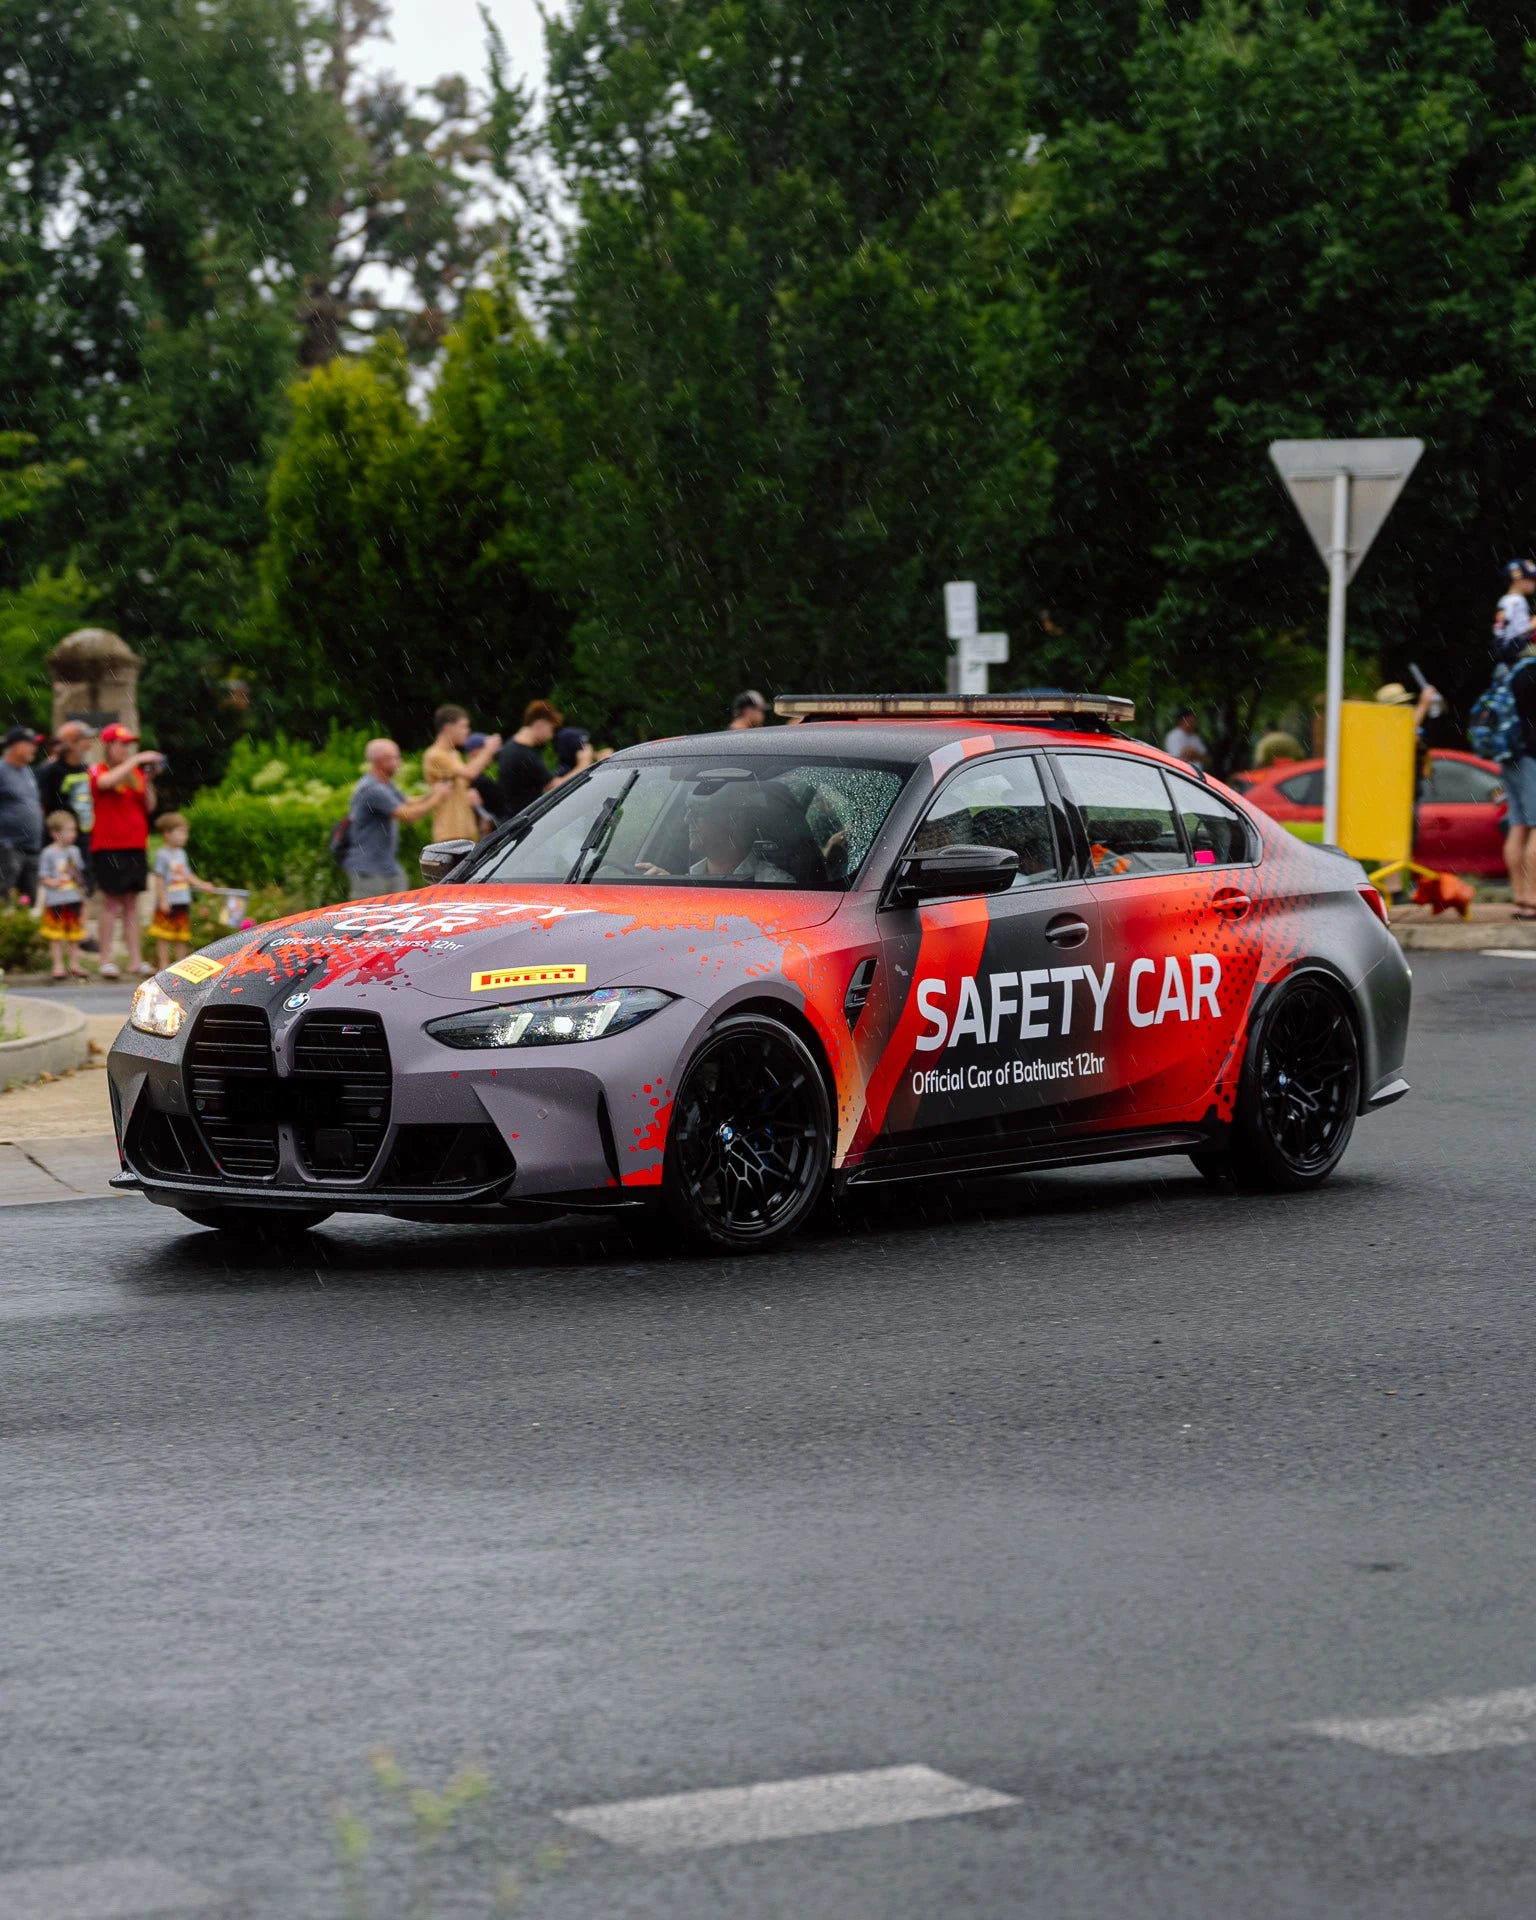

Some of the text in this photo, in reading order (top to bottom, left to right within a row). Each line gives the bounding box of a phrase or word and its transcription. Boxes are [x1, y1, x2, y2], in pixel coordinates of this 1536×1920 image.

[322, 902, 599, 919] SAFETY
[333, 915, 480, 933] CAR
[270, 937, 322, 947] Official
[321, 937, 349, 946] Car
[348, 939, 366, 948] of
[430, 939, 465, 951] 12hr
[480, 967, 576, 986] PIRELLI
[915, 952, 1222, 1052] SAFETY CAR
[912, 1052, 1105, 1095] Official Car of Bathurst 12hr
